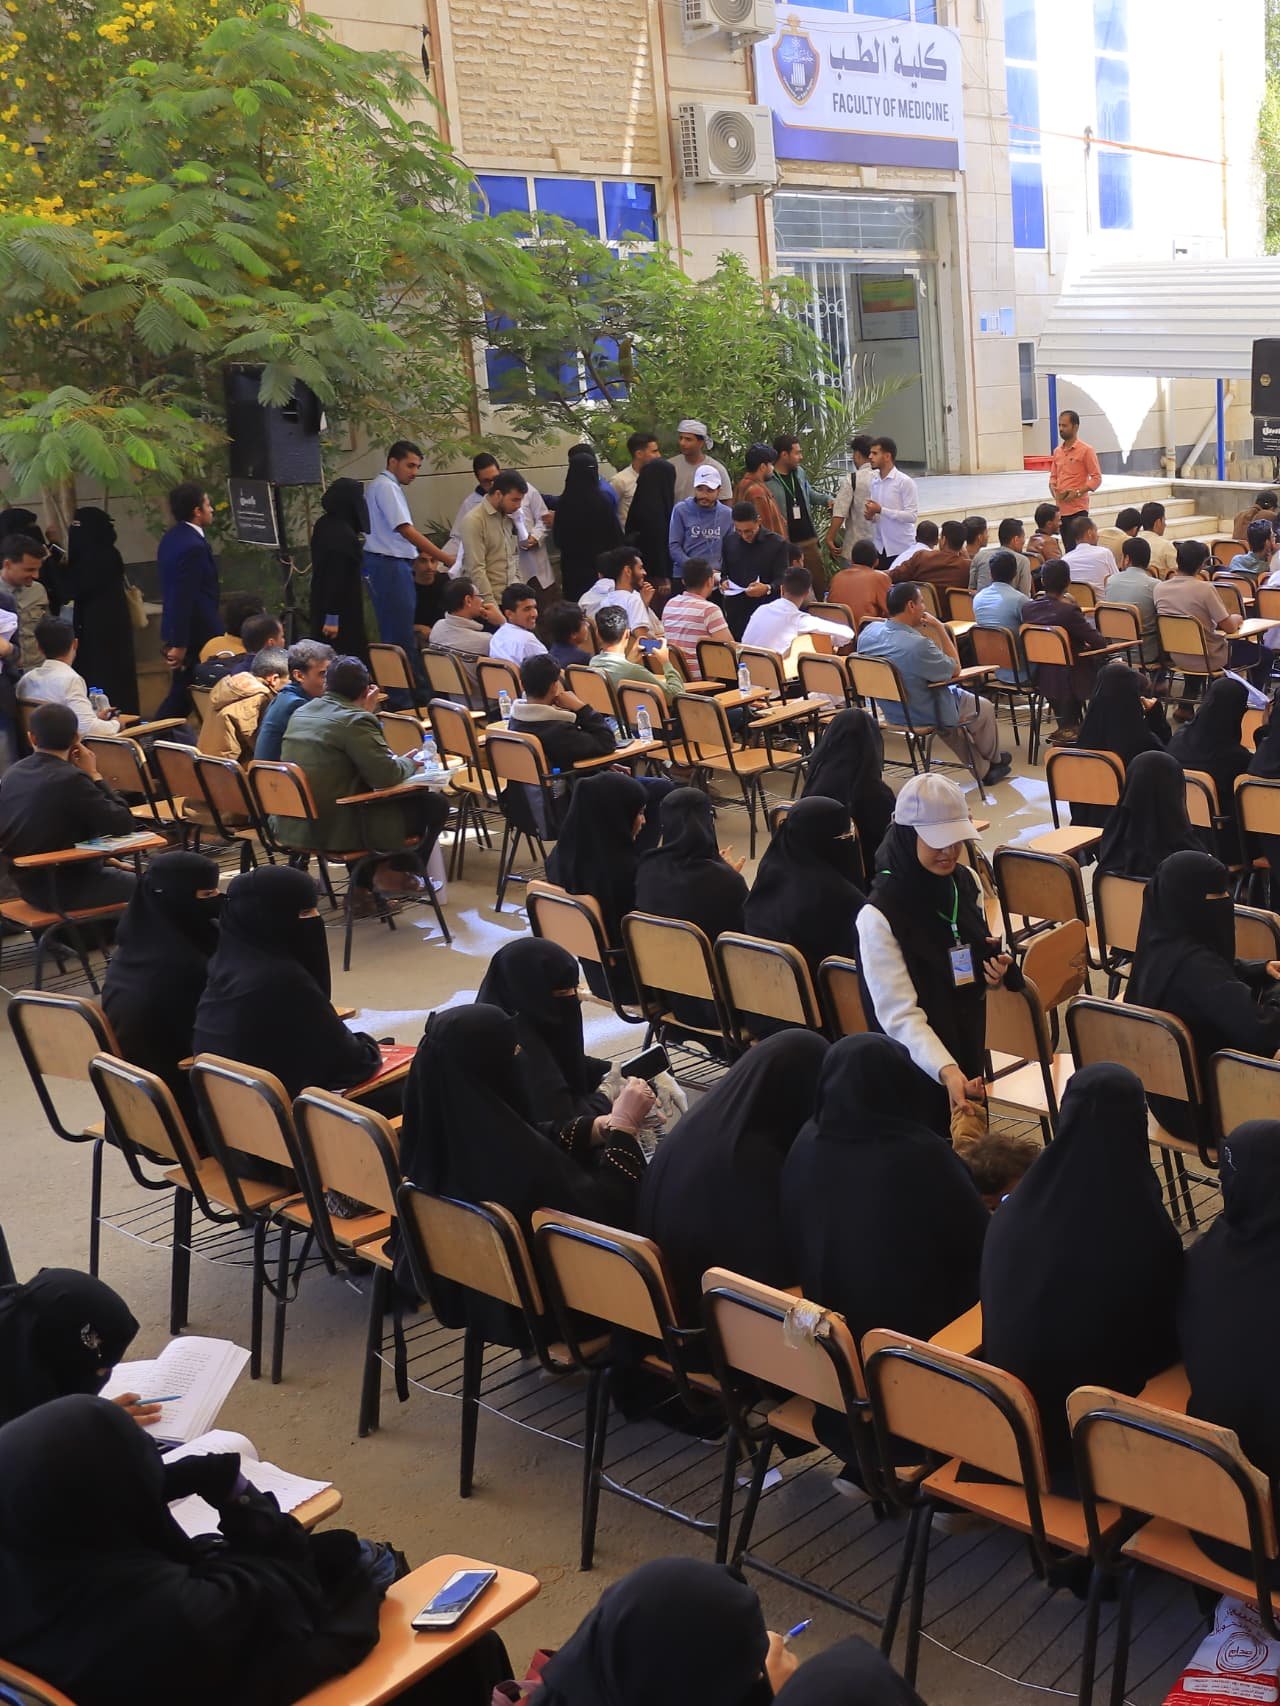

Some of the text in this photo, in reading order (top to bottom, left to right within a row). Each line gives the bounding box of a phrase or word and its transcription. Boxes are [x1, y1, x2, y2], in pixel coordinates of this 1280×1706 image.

[829, 33, 947, 88] كلية الطب
[832, 92, 949, 122] FACULTY OF MEDICINE
[691, 525, 720, 535] Good
